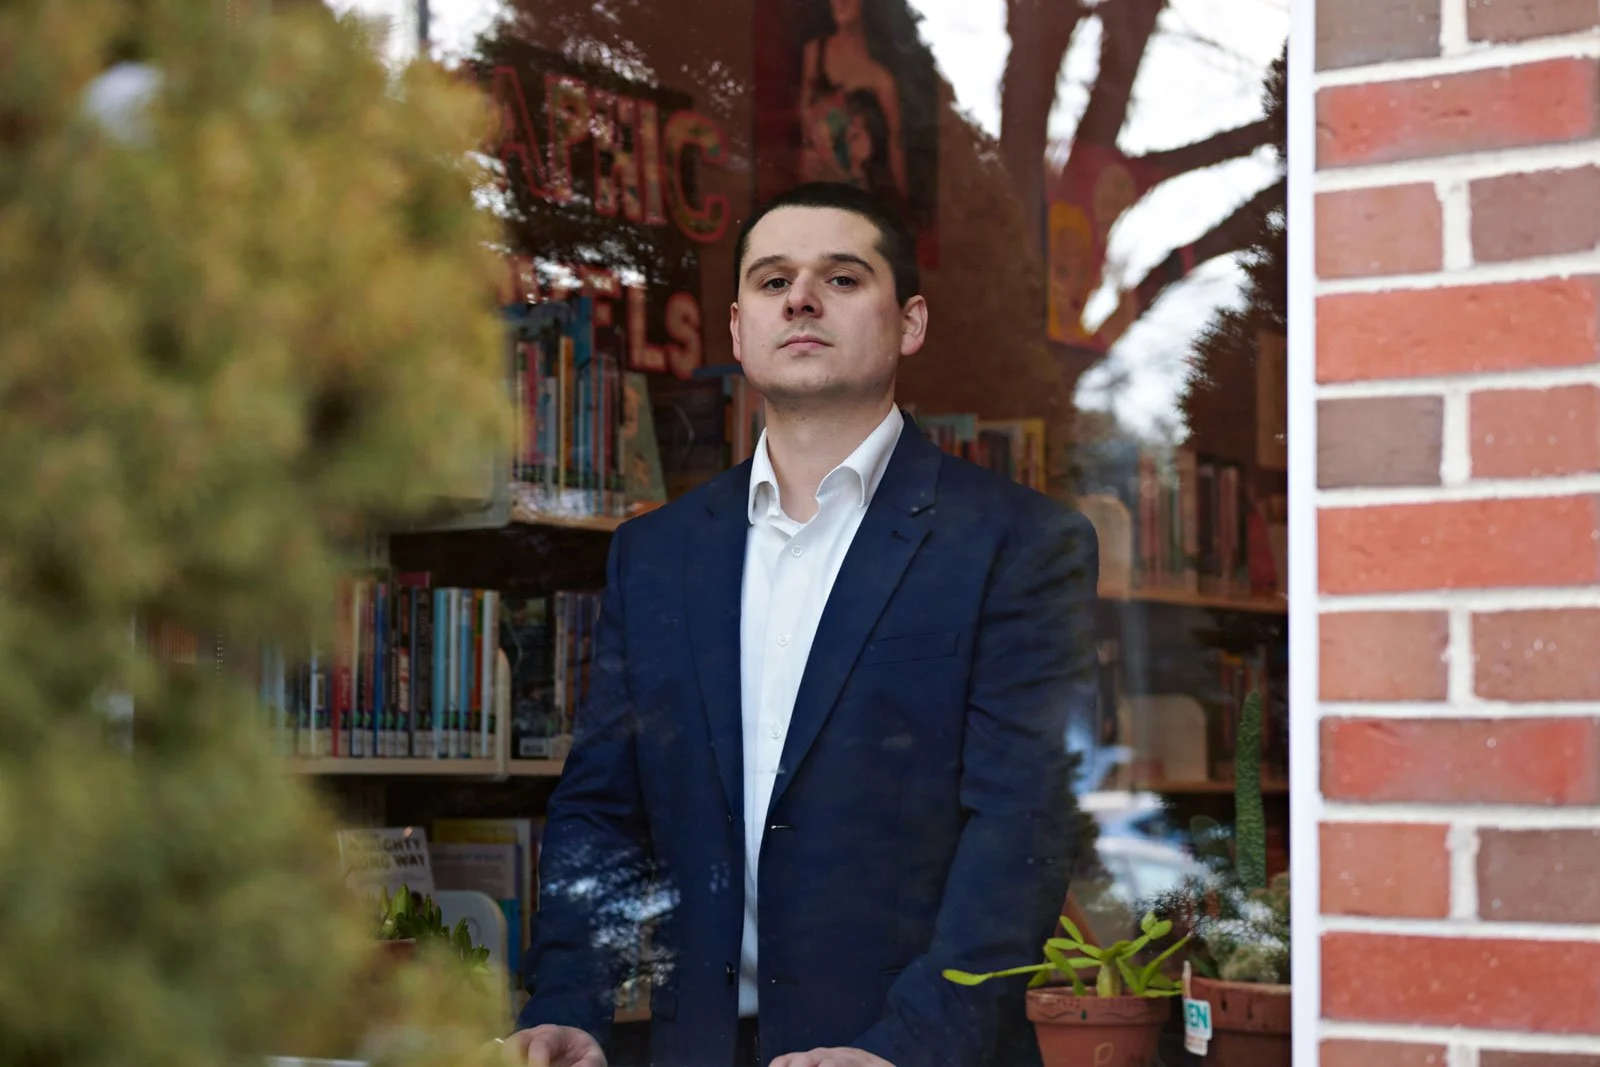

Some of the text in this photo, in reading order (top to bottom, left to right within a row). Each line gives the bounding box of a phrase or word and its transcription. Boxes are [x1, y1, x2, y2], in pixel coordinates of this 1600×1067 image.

[478, 64, 731, 244] APHIC
[393, 853, 426, 868] WAY
[1185, 1002, 1209, 1029] EN
